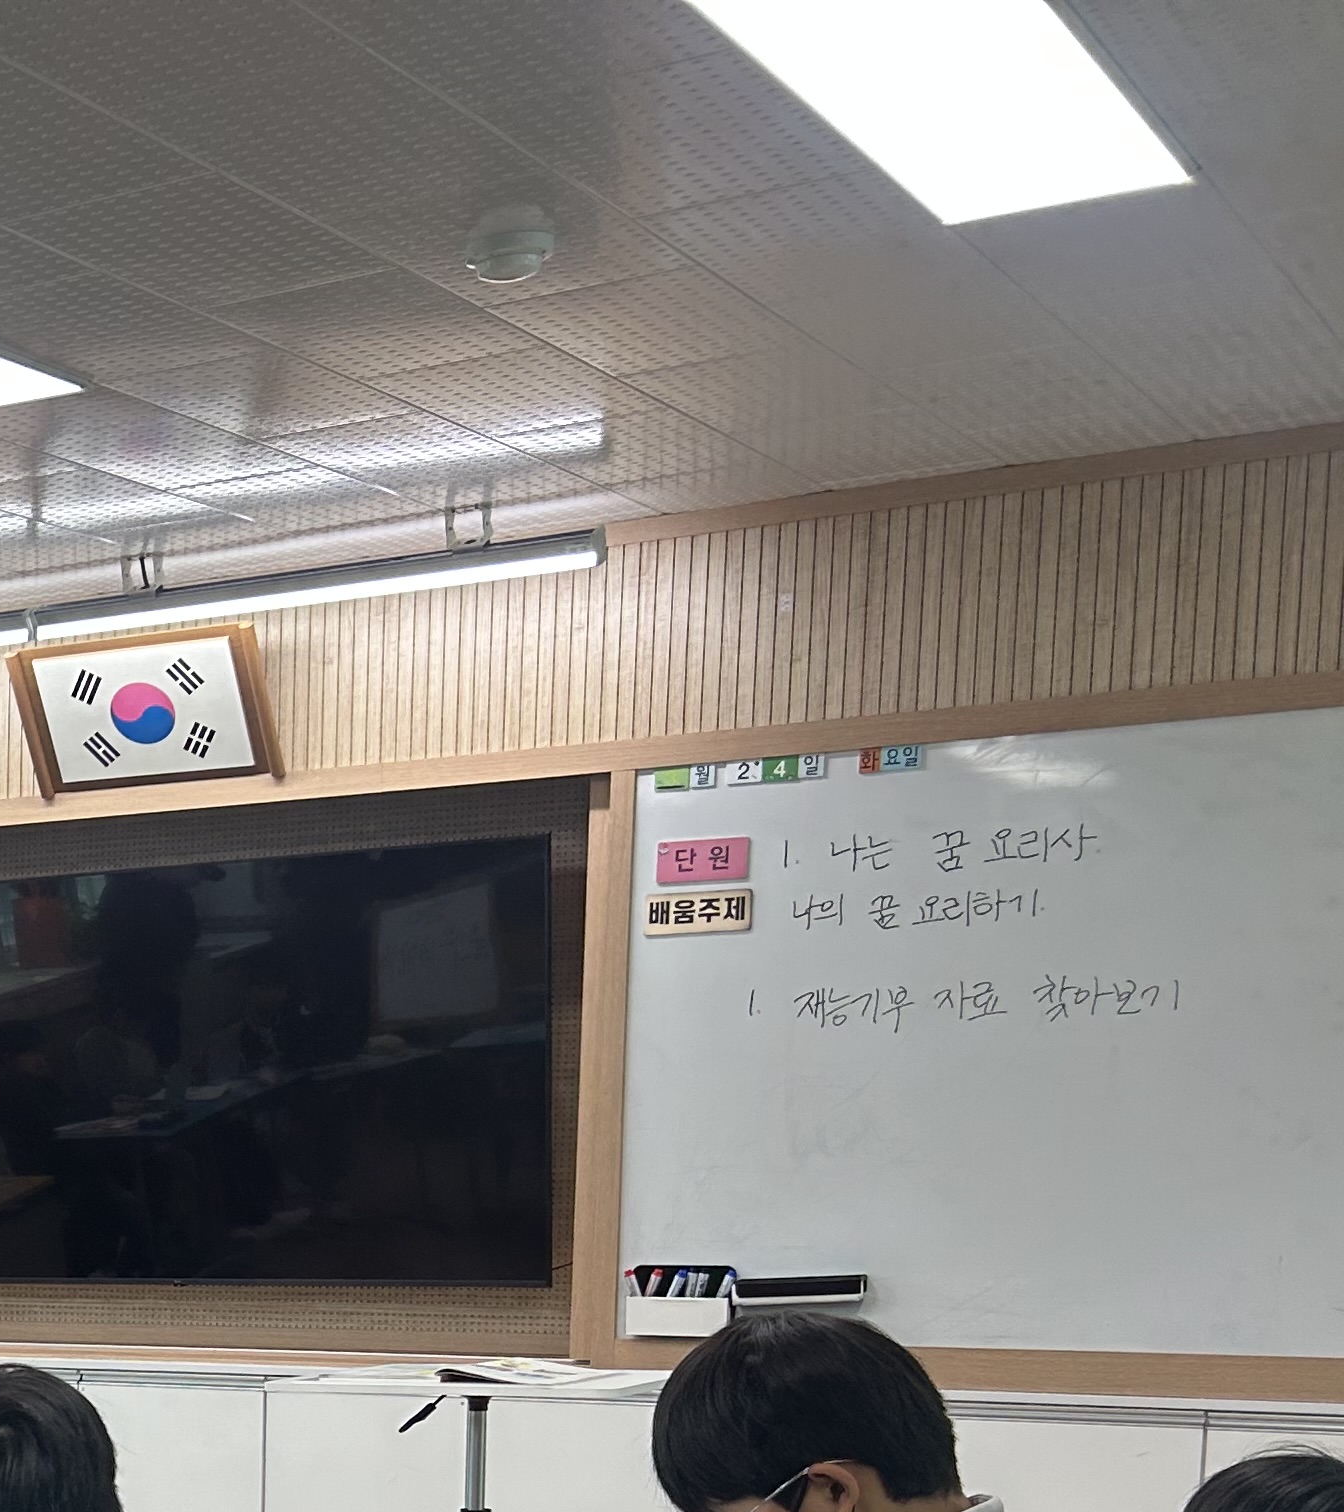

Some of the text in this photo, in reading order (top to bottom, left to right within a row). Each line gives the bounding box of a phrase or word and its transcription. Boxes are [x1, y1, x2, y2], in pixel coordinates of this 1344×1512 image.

[831, 834, 893, 872] 나는
[932, 830, 970, 872] 꿈
[648, 896, 746, 925] 배움주제
[792, 893, 843, 930] 나의
[795, 985, 915, 1033] 재능기부
[934, 981, 1007, 1022] 자료
[1033, 974, 1179, 1022] 찾아보기
